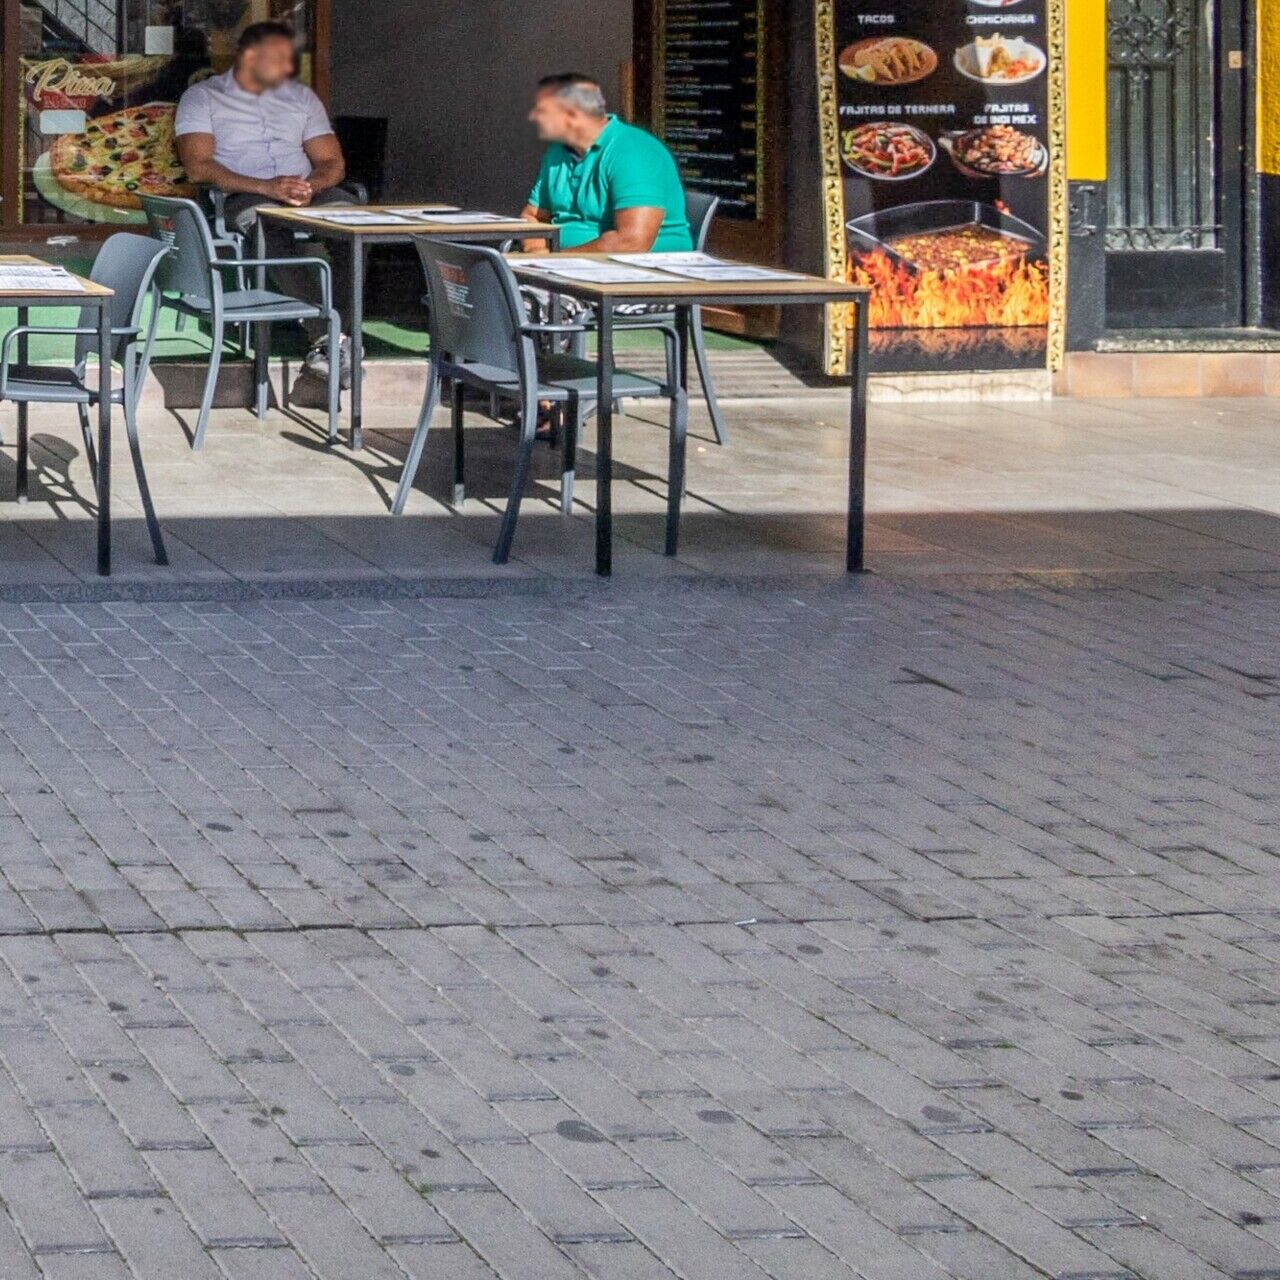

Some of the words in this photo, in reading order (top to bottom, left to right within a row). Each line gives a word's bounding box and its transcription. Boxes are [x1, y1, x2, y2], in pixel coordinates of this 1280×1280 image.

[857, 15, 895, 24] TACOS
[966, 14, 1036, 24] CHIMICHANGA
[839, 104, 885, 115] FAJITAS
[887, 104, 902, 114] DE
[904, 104, 955, 114] TERNERA
[984, 103, 1030, 113] FAJITAS
[974, 115, 988, 124] DE
[1011, 115, 1037, 124] MEX
